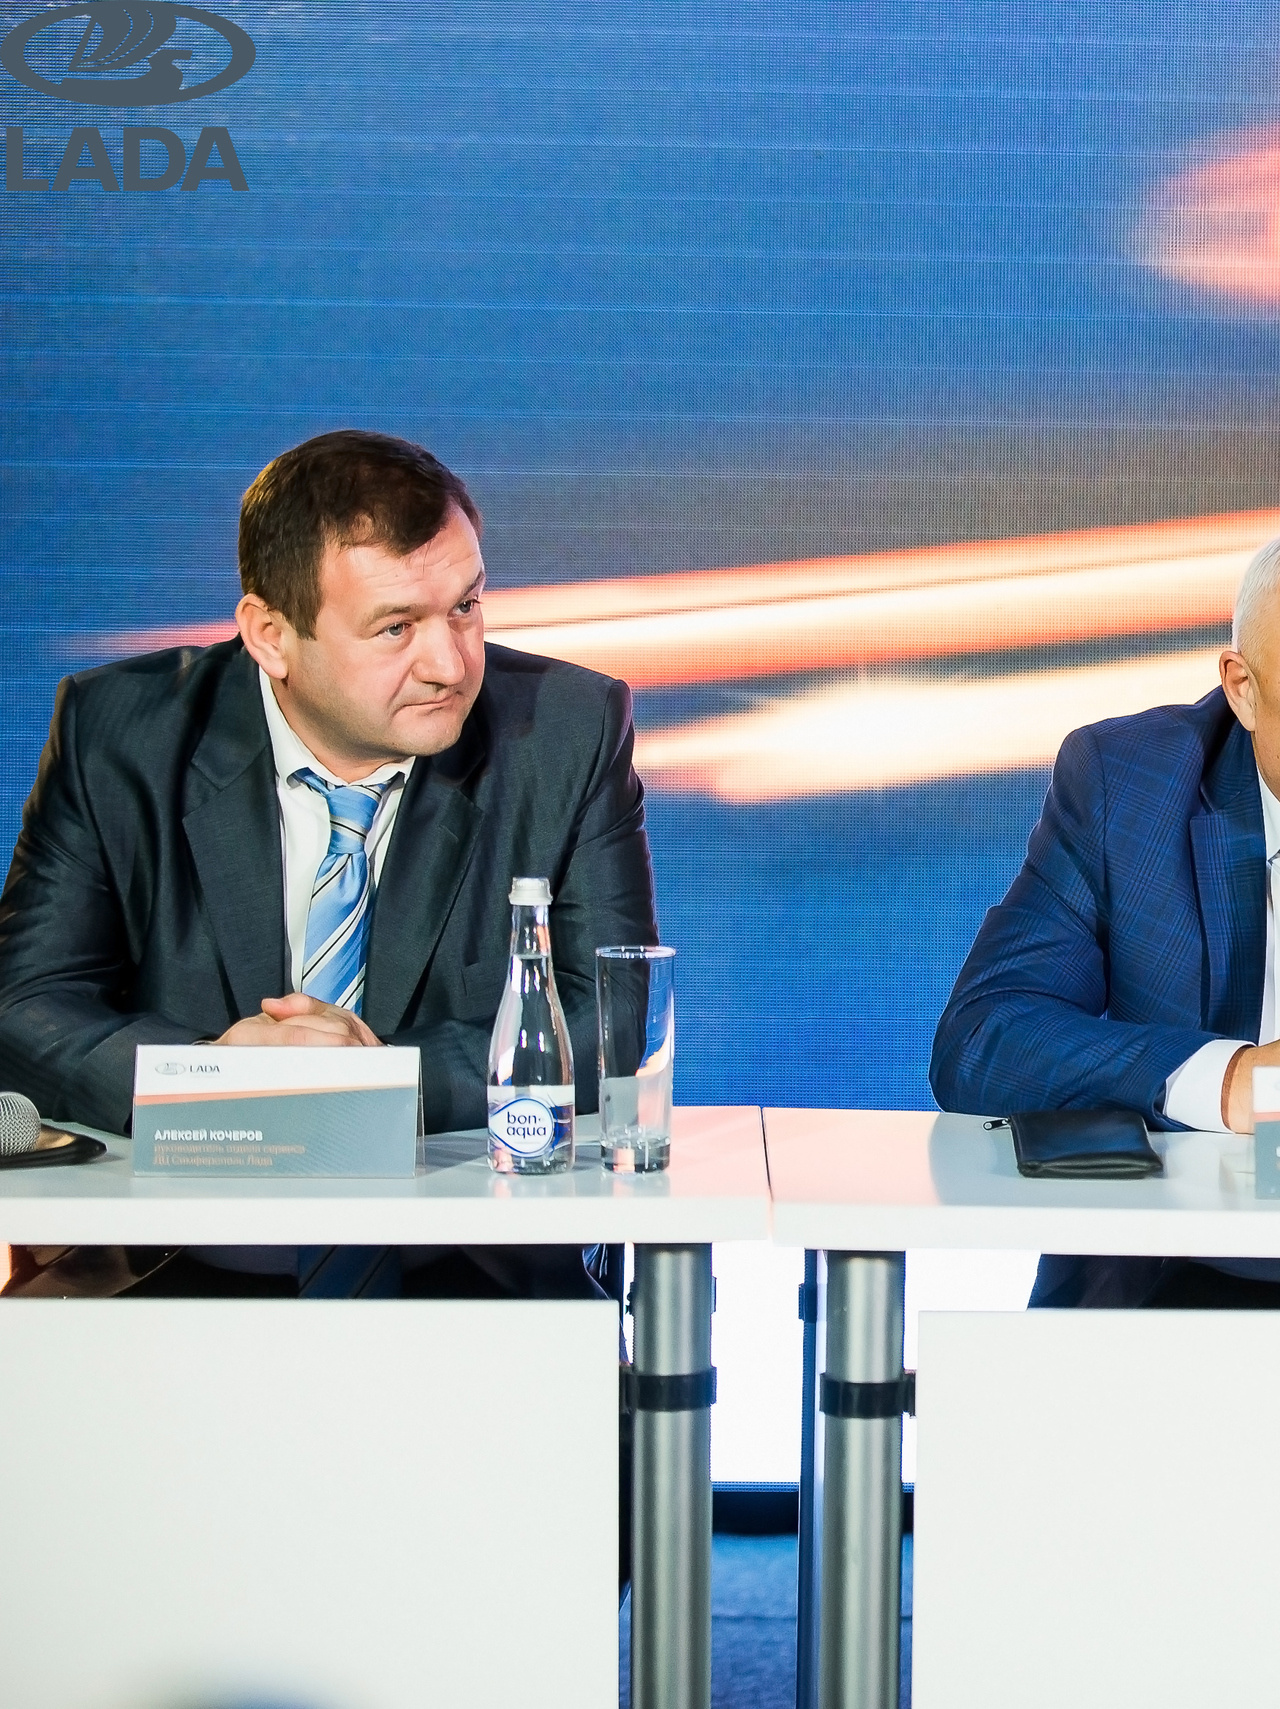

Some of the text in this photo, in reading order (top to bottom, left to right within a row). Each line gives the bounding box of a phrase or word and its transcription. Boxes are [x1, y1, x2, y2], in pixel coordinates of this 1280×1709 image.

[189, 1065, 221, 1073] LADA
[154, 1128, 263, 1141] АЛЕКСЕЙ КОЧЕРОВ
[506, 1126, 546, 1139] aqua
